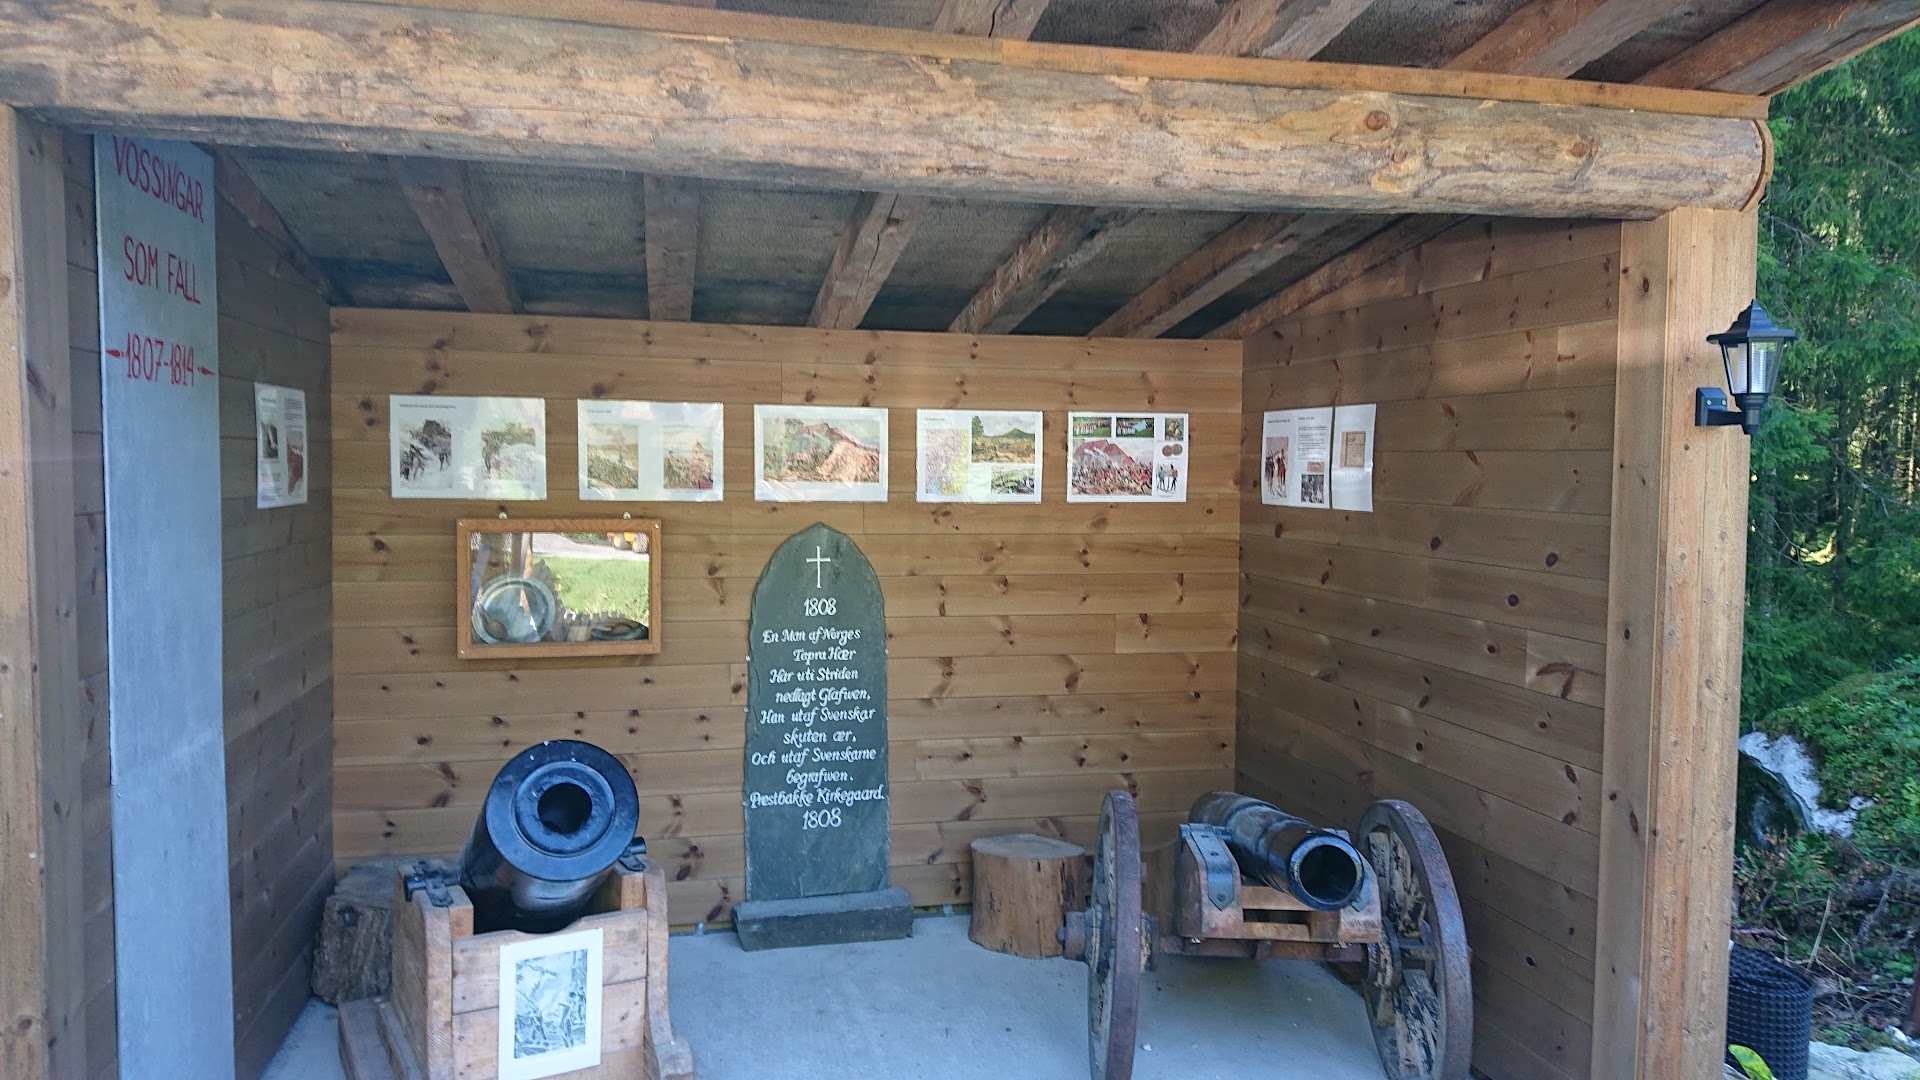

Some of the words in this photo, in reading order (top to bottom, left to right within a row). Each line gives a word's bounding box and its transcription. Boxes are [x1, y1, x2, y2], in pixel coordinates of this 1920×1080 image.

[123, 235, 159, 290] SOM
[168, 252, 201, 305] FALL
[125, 332, 195, 387] 1807-1814
[803, 597, 837, 617] 1808
[762, 629, 779, 644] En
[781, 629, 806, 643] Man
[808, 626, 823, 644] af
[822, 626, 862, 646] Norges
[792, 648, 828, 665] Tapra
[828, 646, 857, 661] Hær
[796, 667, 815, 682] uti
[816, 666, 860, 682] Striden
[775, 687, 817, 708] nedlagt
[760, 709, 785, 724] Han
[791, 707, 820, 727] utaf
[820, 706, 877, 723] Svenskar
[783, 728, 827, 748] skuten
[751, 750, 776, 766] Och
[781, 748, 810, 768] utaf
[811, 746, 877, 763] Svenskarne
[750, 789, 814, 809] Prestbakke
[802, 807, 842, 830] 1808
